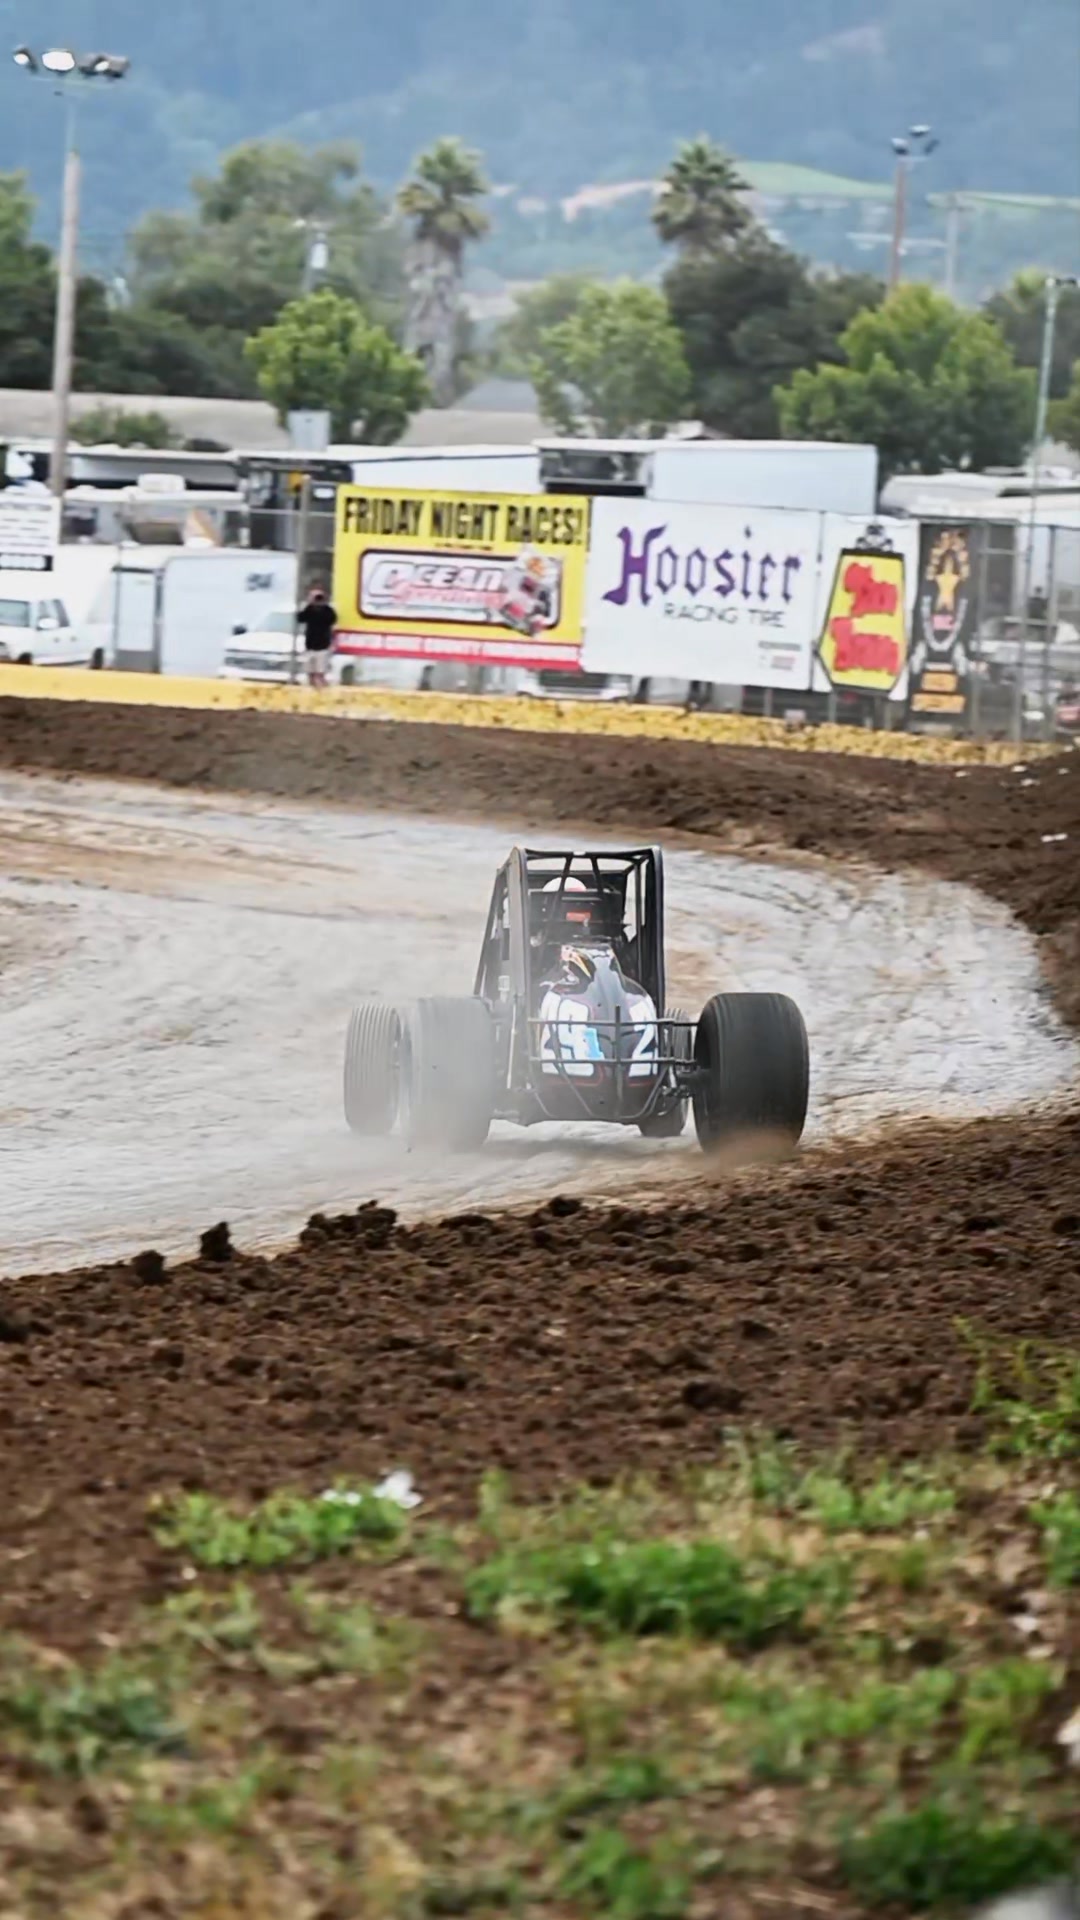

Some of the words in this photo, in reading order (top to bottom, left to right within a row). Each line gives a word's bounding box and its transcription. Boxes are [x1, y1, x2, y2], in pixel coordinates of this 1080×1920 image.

[343, 496, 424, 537] FRIDAY
[430, 501, 499, 542] NIGHT
[505, 505, 583, 546] RACES!
[602, 523, 802, 607] Hoosier
[663, 602, 739, 625] RACING
